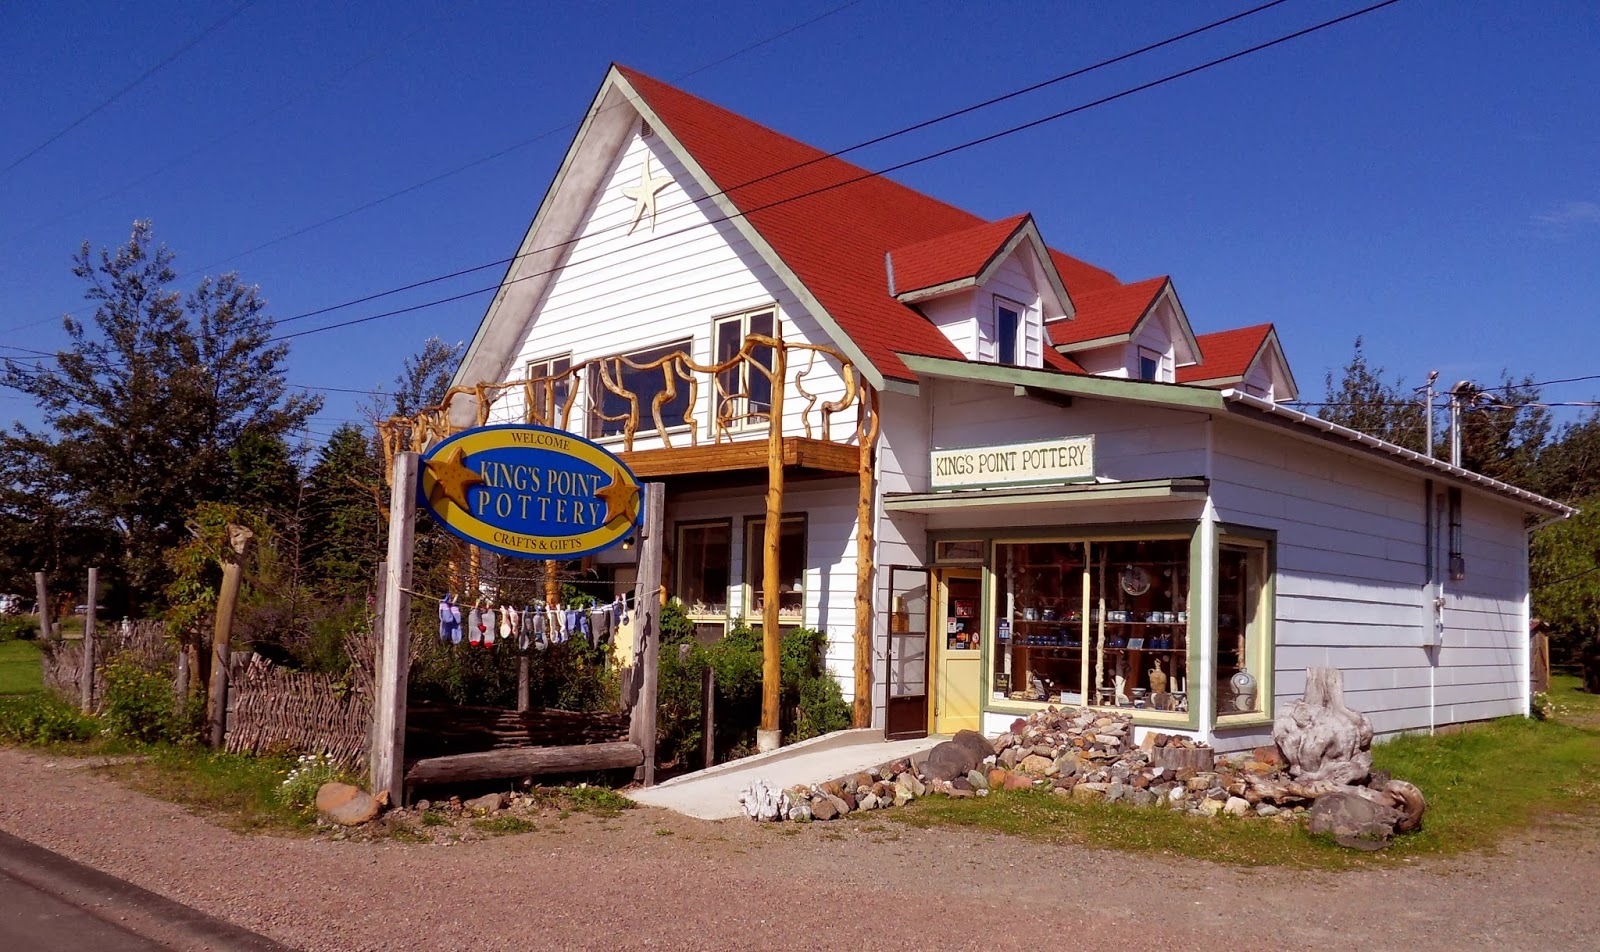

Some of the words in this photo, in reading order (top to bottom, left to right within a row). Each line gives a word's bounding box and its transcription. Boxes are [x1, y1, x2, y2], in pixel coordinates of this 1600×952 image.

[512, 432, 570, 450] WELCOME
[936, 454, 974, 476] KING'S
[979, 452, 1018, 473] POINT
[1023, 445, 1087, 470] POTTERY
[480, 461, 540, 492] KING'S
[547, 469, 601, 498] POINT
[478, 490, 600, 526] POTTERY
[493, 531, 537, 550] CRAFTS
[550, 537, 582, 550] GIFTS
